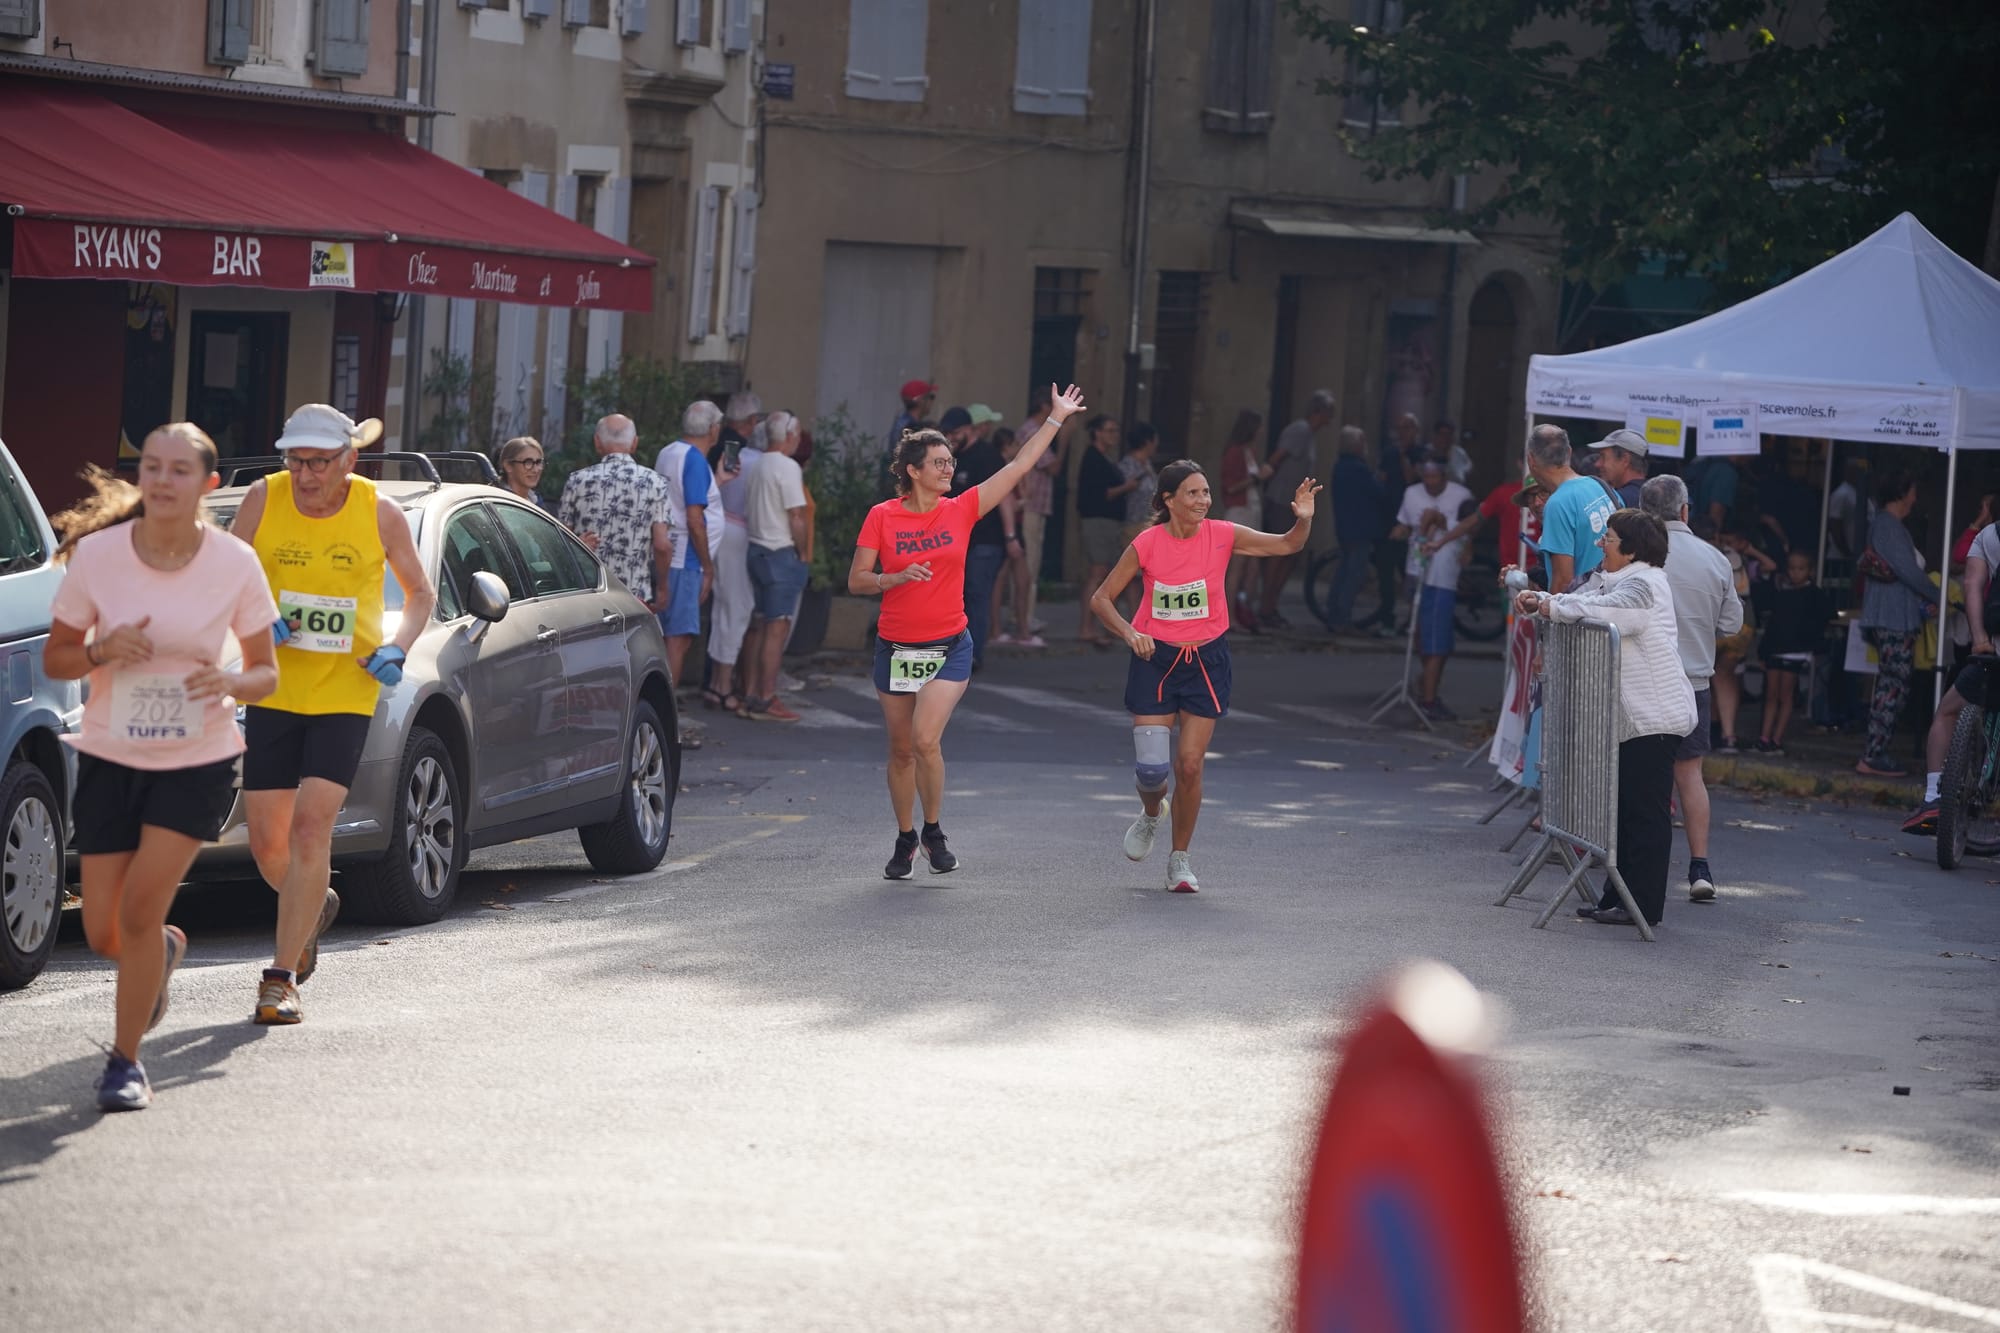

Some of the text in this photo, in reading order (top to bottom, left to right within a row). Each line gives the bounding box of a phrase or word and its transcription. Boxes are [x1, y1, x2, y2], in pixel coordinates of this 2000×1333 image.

[74, 225, 261, 276] RYAN'S BAR
[408, 251, 600, 304] Chez Martine et John
[1707, 408, 1751, 417] INSCRIPTIONS
[896, 530, 925, 539] 10KM
[896, 531, 953, 555] PARIS
[1160, 592, 1200, 609] 116
[290, 608, 345, 634] 160
[900, 661, 938, 678] 159
[129, 699, 184, 723] 202
[126, 724, 187, 738] TUFF'S
